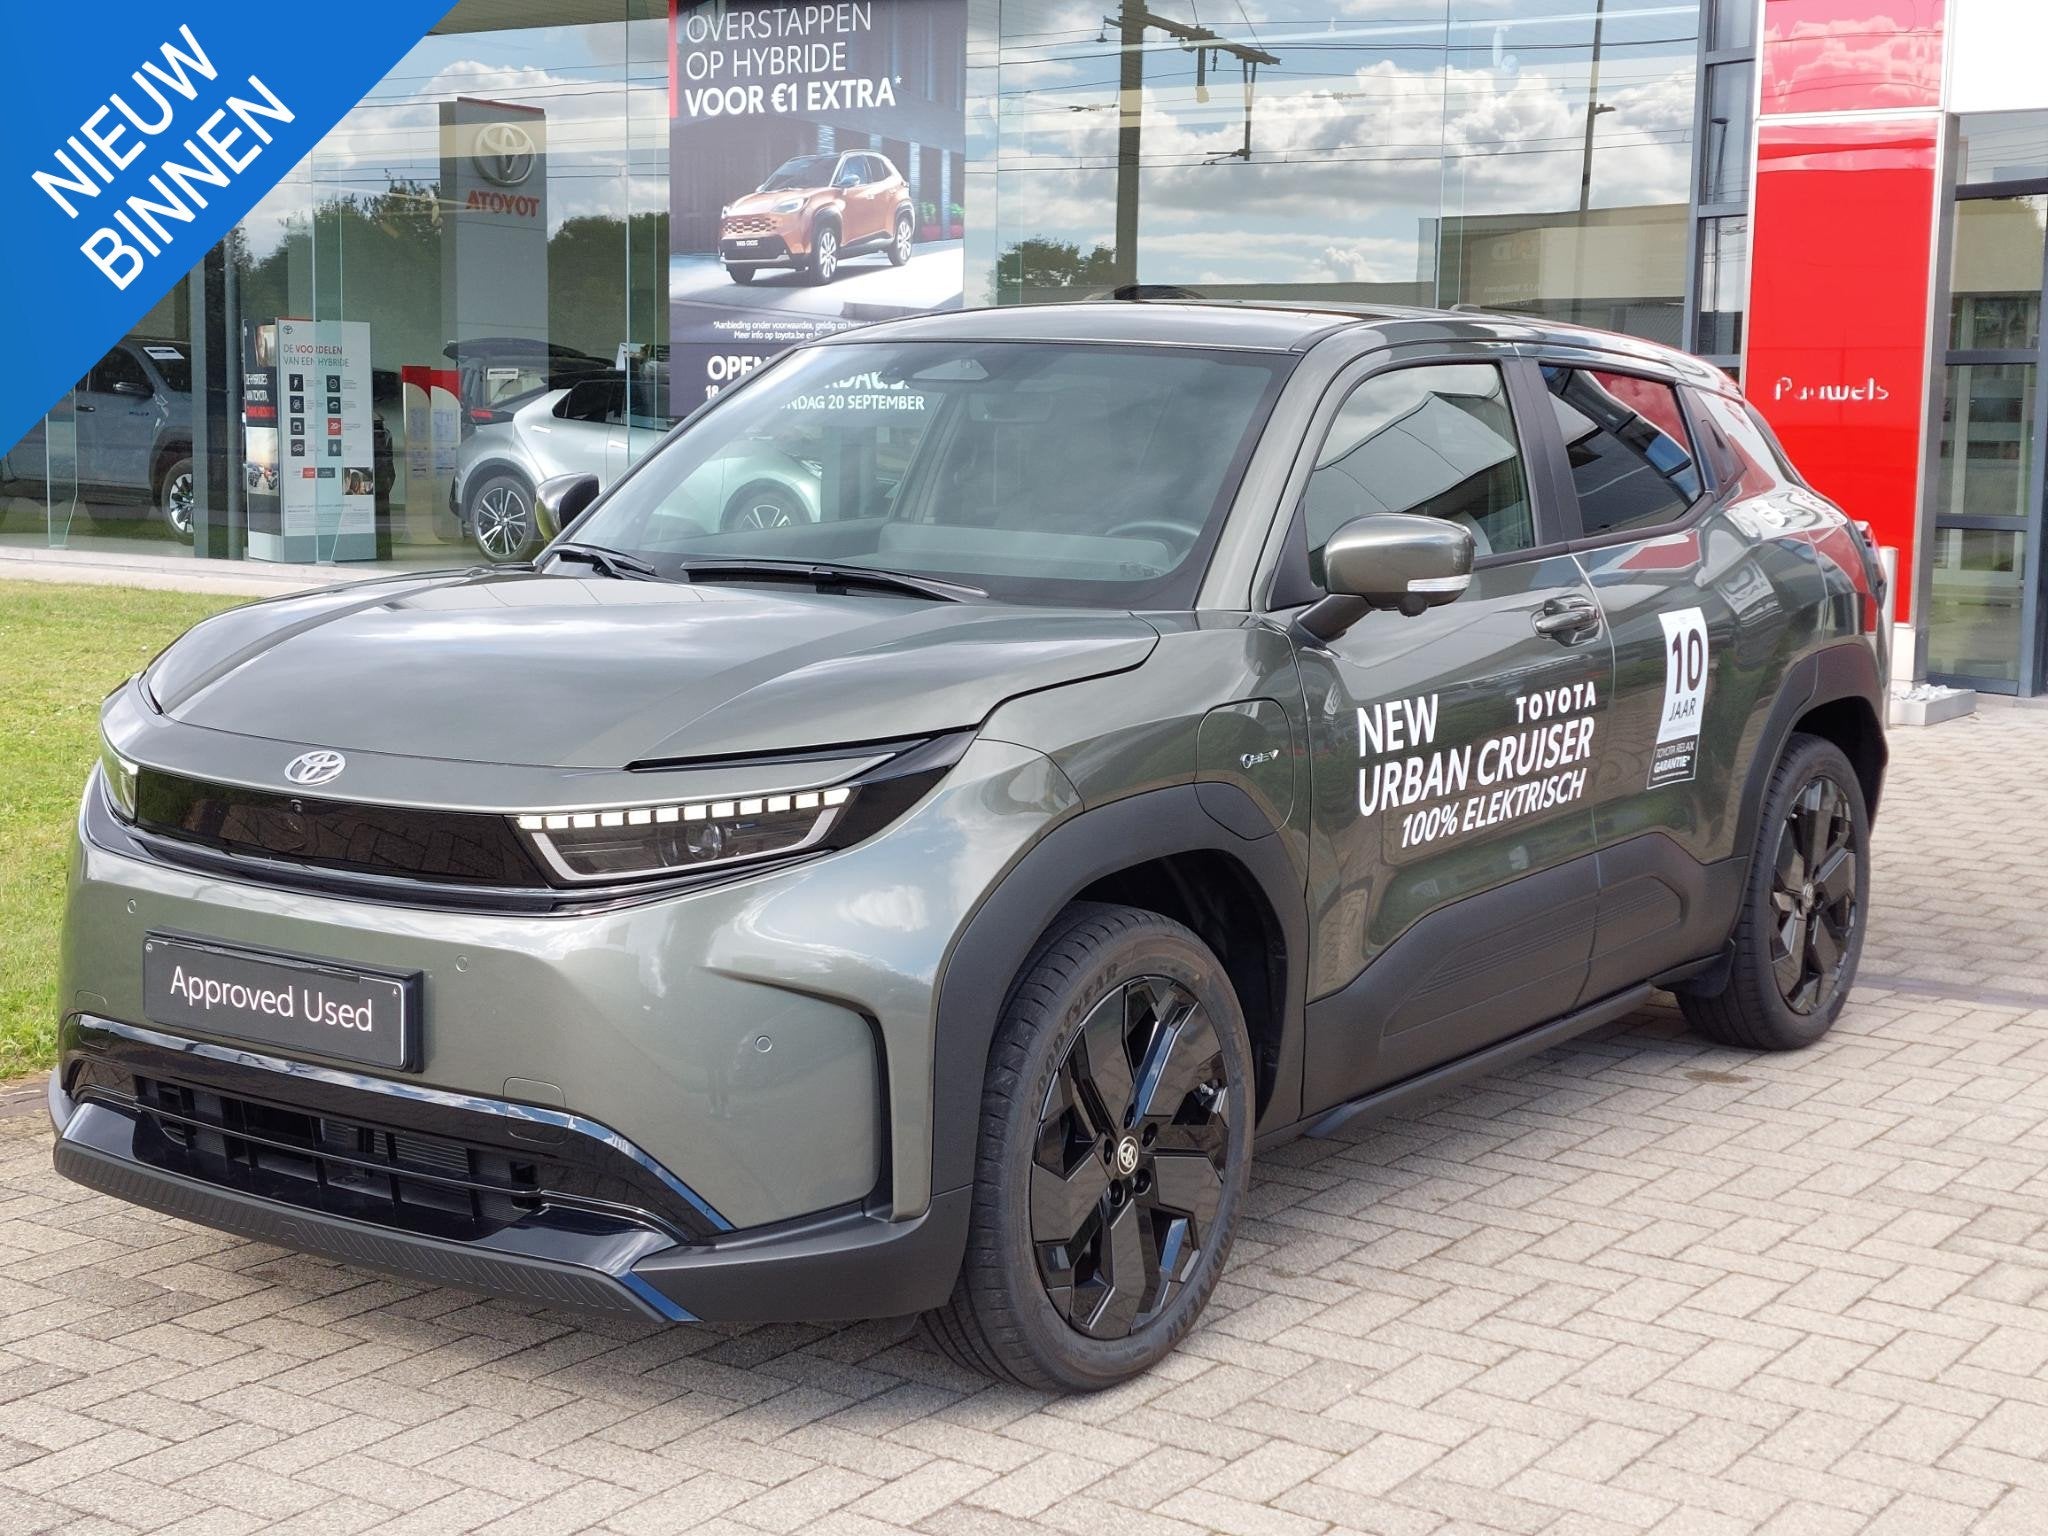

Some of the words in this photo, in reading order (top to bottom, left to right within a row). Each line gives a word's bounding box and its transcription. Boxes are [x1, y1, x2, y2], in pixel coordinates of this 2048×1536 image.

[686, 1, 871, 44] OVERSTAPPEN
[686, 51, 724, 80] OP
[733, 41, 847, 77] HYBRIDE
[685, 84, 765, 117] VOOR
[771, 82, 798, 113] €1
[283, 344, 294, 353] DE
[295, 344, 343, 355] VOODELEN
[828, 394, 844, 409] 20
[847, 394, 925, 410] SEPTEMBER
[1672, 628, 1703, 695] 10
[1357, 694, 1438, 757] NEW
[1516, 681, 1597, 723] TOYOTA
[1669, 697, 1696, 722] JAAR
[1358, 745, 1471, 817] URBAN
[1477, 716, 1595, 786] CRUISER
[1402, 801, 1459, 848] 100%
[1462, 767, 1588, 832] ELEKTRISCH
[170, 965, 294, 1018] Approved
[304, 989, 372, 1032] Used
